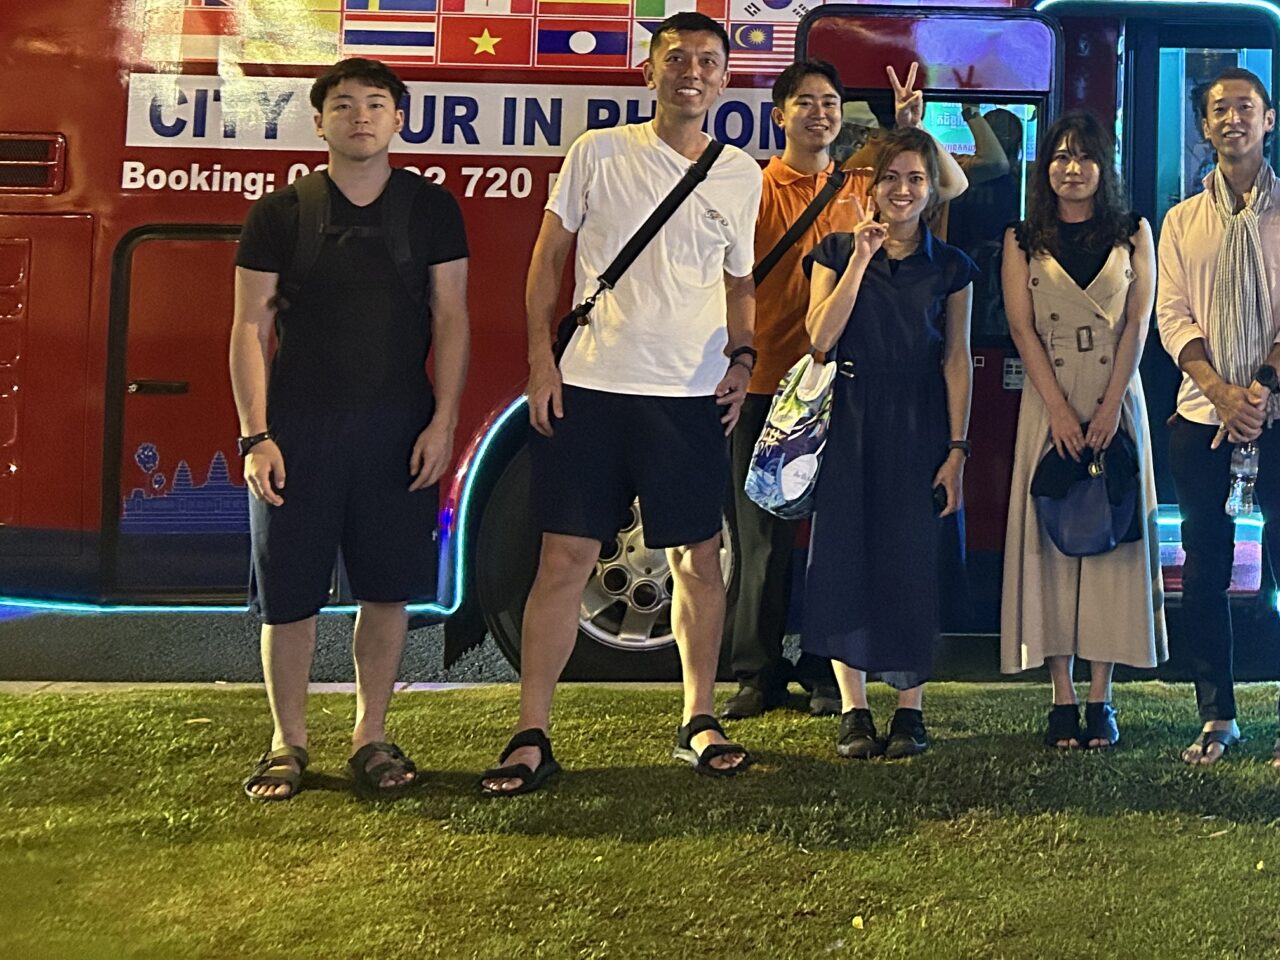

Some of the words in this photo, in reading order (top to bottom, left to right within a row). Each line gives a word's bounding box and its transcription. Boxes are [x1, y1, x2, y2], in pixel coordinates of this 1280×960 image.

[399, 95, 480, 145] UR
[502, 97, 563, 147] IN
[587, 98, 786, 150] PHOM
[121, 161, 275, 200] Booking:
[461, 167, 532, 199] 720
